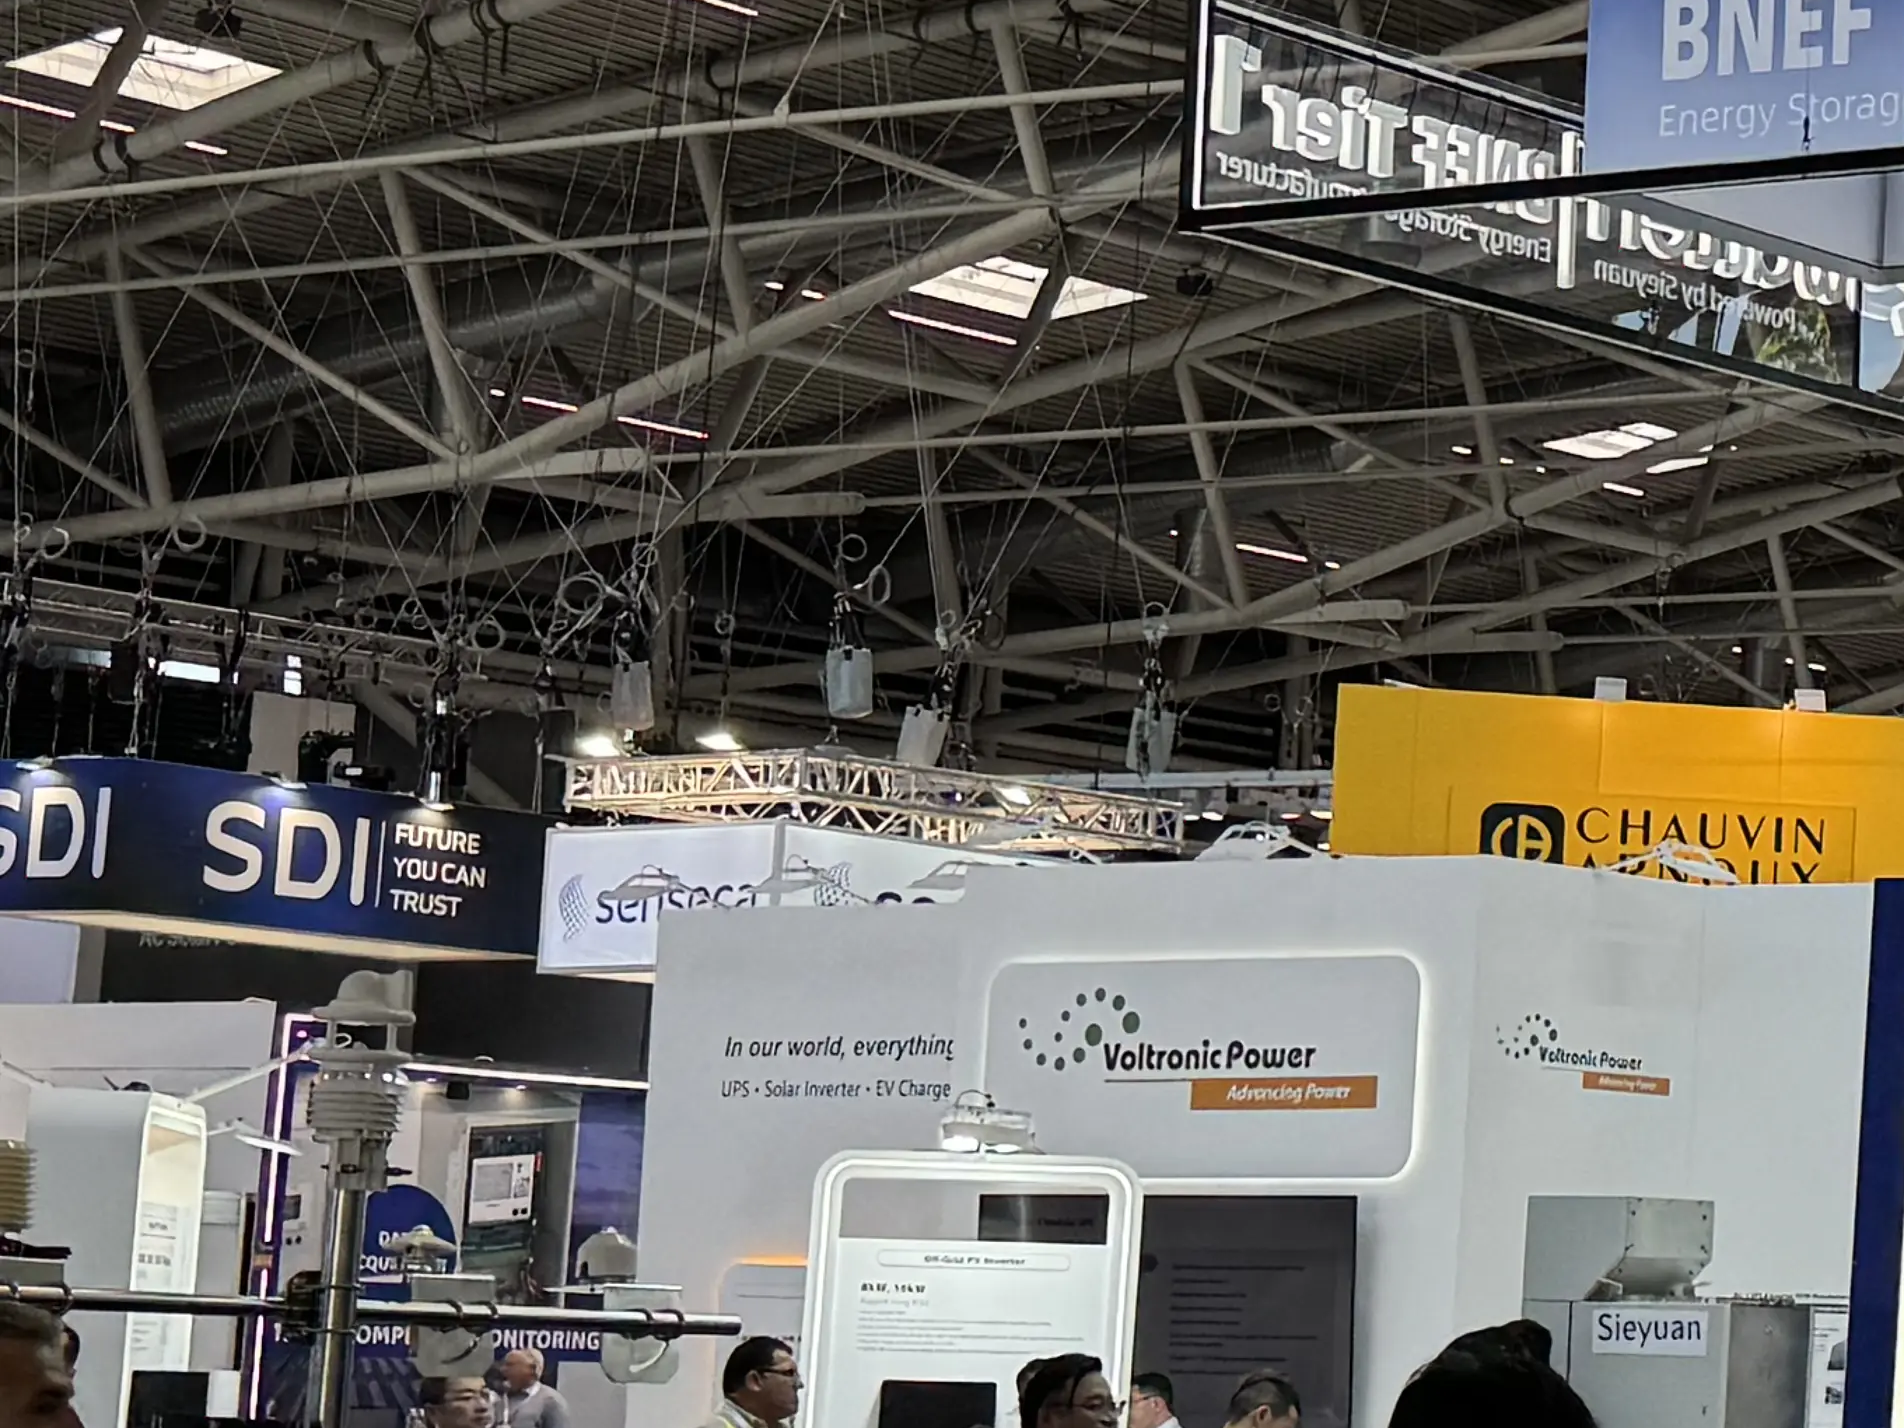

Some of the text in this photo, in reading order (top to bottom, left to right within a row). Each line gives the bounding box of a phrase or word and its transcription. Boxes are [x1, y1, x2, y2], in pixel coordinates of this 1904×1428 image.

[1660, 99, 1776, 138] Energy
[1788, 88, 1903, 131] Storag
[395, 823, 481, 855] FUTURE
[1576, 807, 1824, 855] CHAUVIN
[203, 800, 370, 907] SDI
[393, 857, 486, 889] YOU CAN
[390, 889, 462, 918] TRUST
[725, 1036, 743, 1057] In
[749, 1040, 782, 1057] our
[788, 1036, 845, 1060] world,
[1104, 1040, 1316, 1072] Voltronic Power
[1539, 1046, 1643, 1070] Voltronic Power
[721, 1080, 750, 1097] UPS
[764, 1080, 800, 1097] Solar
[804, 1080, 861, 1098] Inverter
[876, 1080, 895, 1097] EV
[1304, 1083, 1351, 1102] Power
[490, 1328, 600, 1350] ONITORING
[1598, 1313, 1701, 1347] Sieyuan
